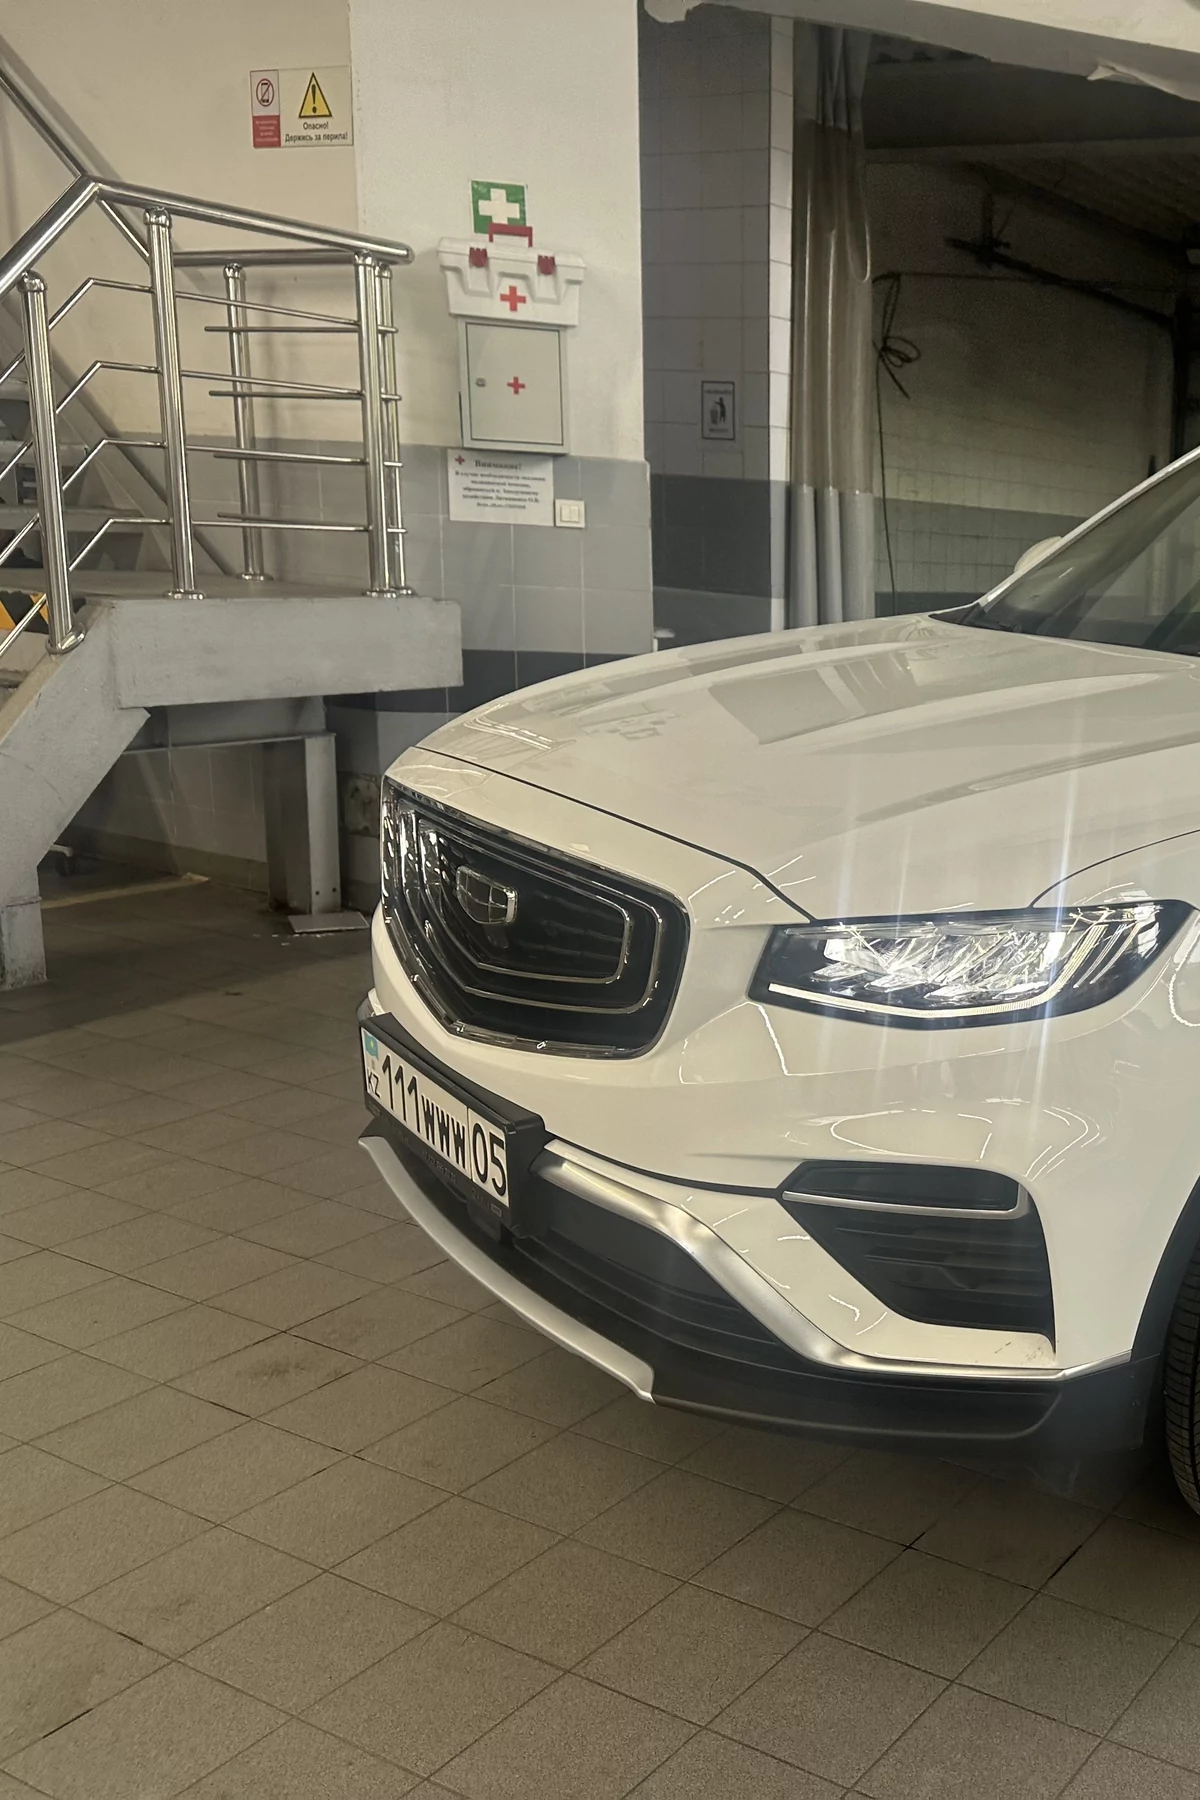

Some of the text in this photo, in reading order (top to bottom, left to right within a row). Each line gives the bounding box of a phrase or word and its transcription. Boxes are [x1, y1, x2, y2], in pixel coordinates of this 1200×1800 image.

[303, 121, 328, 130] Опасно!
[285, 133, 313, 143] Держись
[322, 132, 348, 142] перила!
[366, 1068, 381, 1099] KZ
[382, 1055, 507, 1197] 111WWW 05
